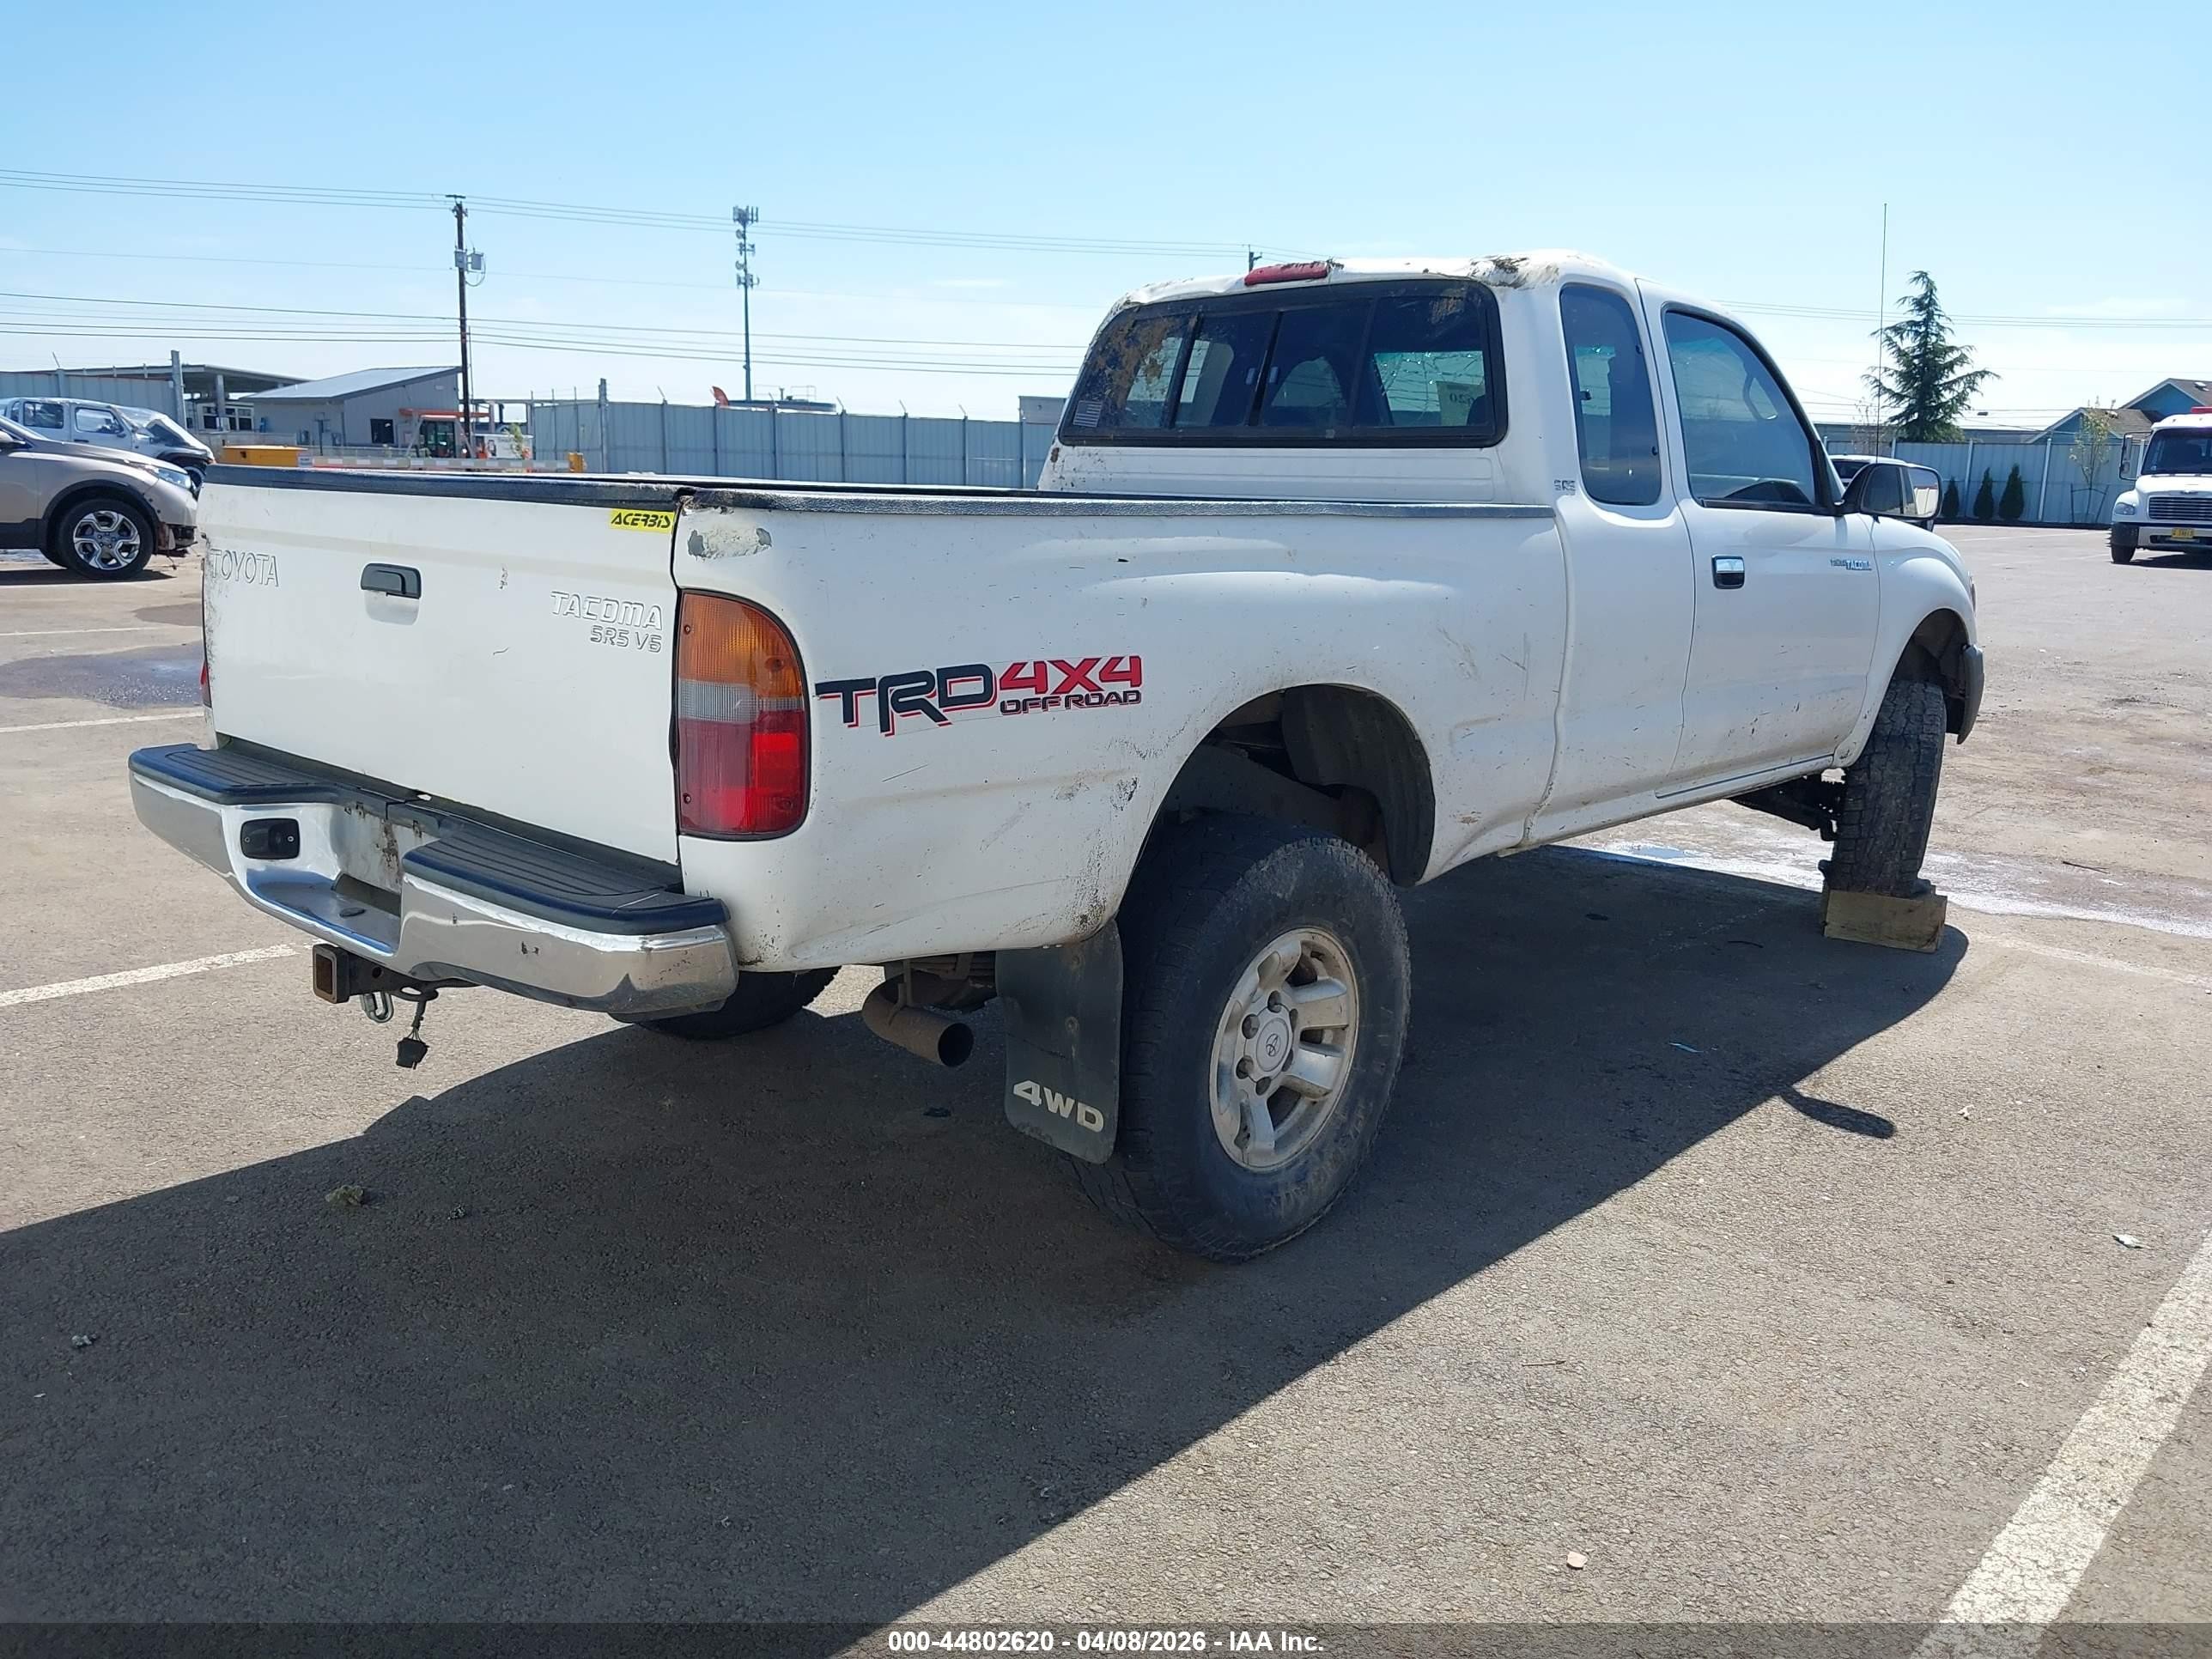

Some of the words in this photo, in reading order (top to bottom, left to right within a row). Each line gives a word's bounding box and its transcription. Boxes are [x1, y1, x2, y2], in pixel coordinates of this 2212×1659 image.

[611, 512, 672, 530] ACERBIS
[210, 548, 279, 587] TOYOTA
[550, 591, 663, 631] TACOMA
[590, 625, 629, 647] SR5
[635, 631, 662, 653] V6
[815, 663, 997, 737] TRD
[999, 655, 1143, 695] 4X4
[1000, 694, 1061, 716] OFF
[1064, 690, 1143, 710] ROAD
[1013, 1080, 1104, 1133] 4WD
